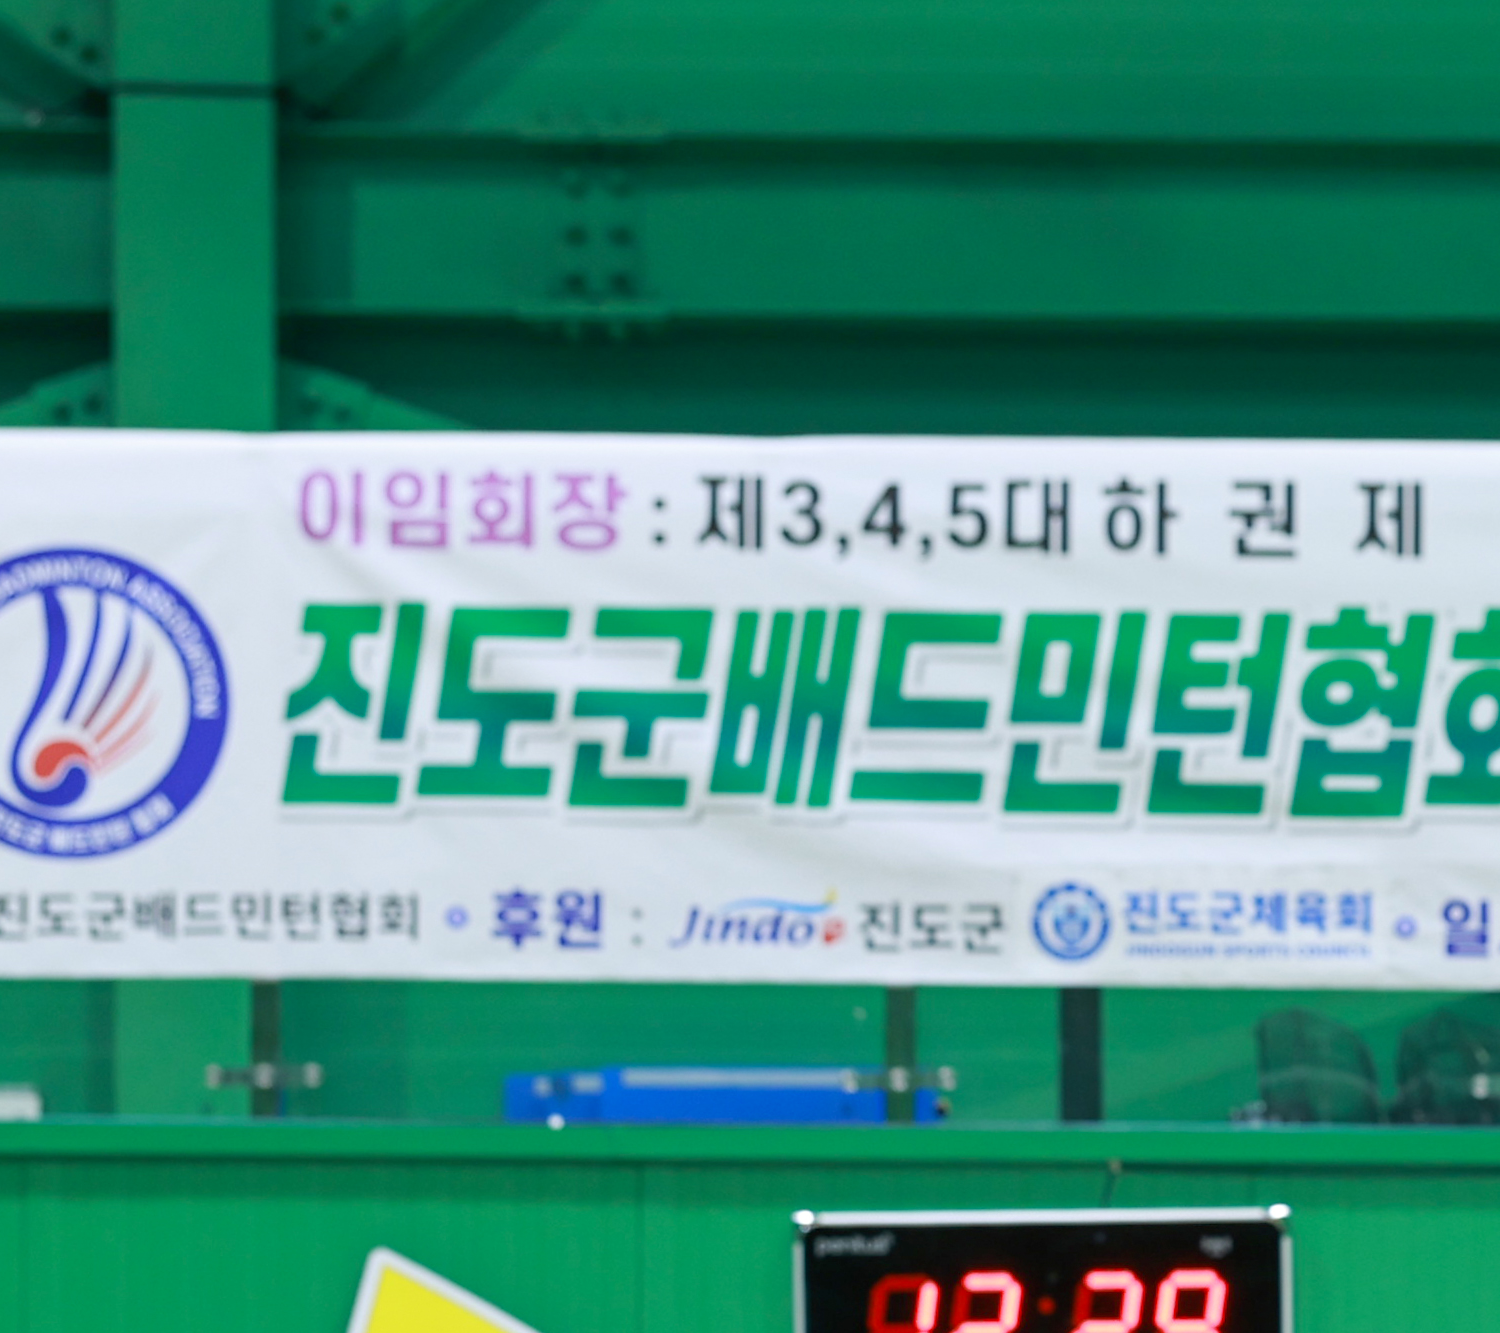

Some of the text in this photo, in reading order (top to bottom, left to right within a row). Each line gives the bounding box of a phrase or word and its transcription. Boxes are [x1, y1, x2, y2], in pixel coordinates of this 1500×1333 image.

[297, 467, 628, 556] 이임회장
[492, 888, 606, 951] 후원
[859, 899, 1005, 955] 진도군
